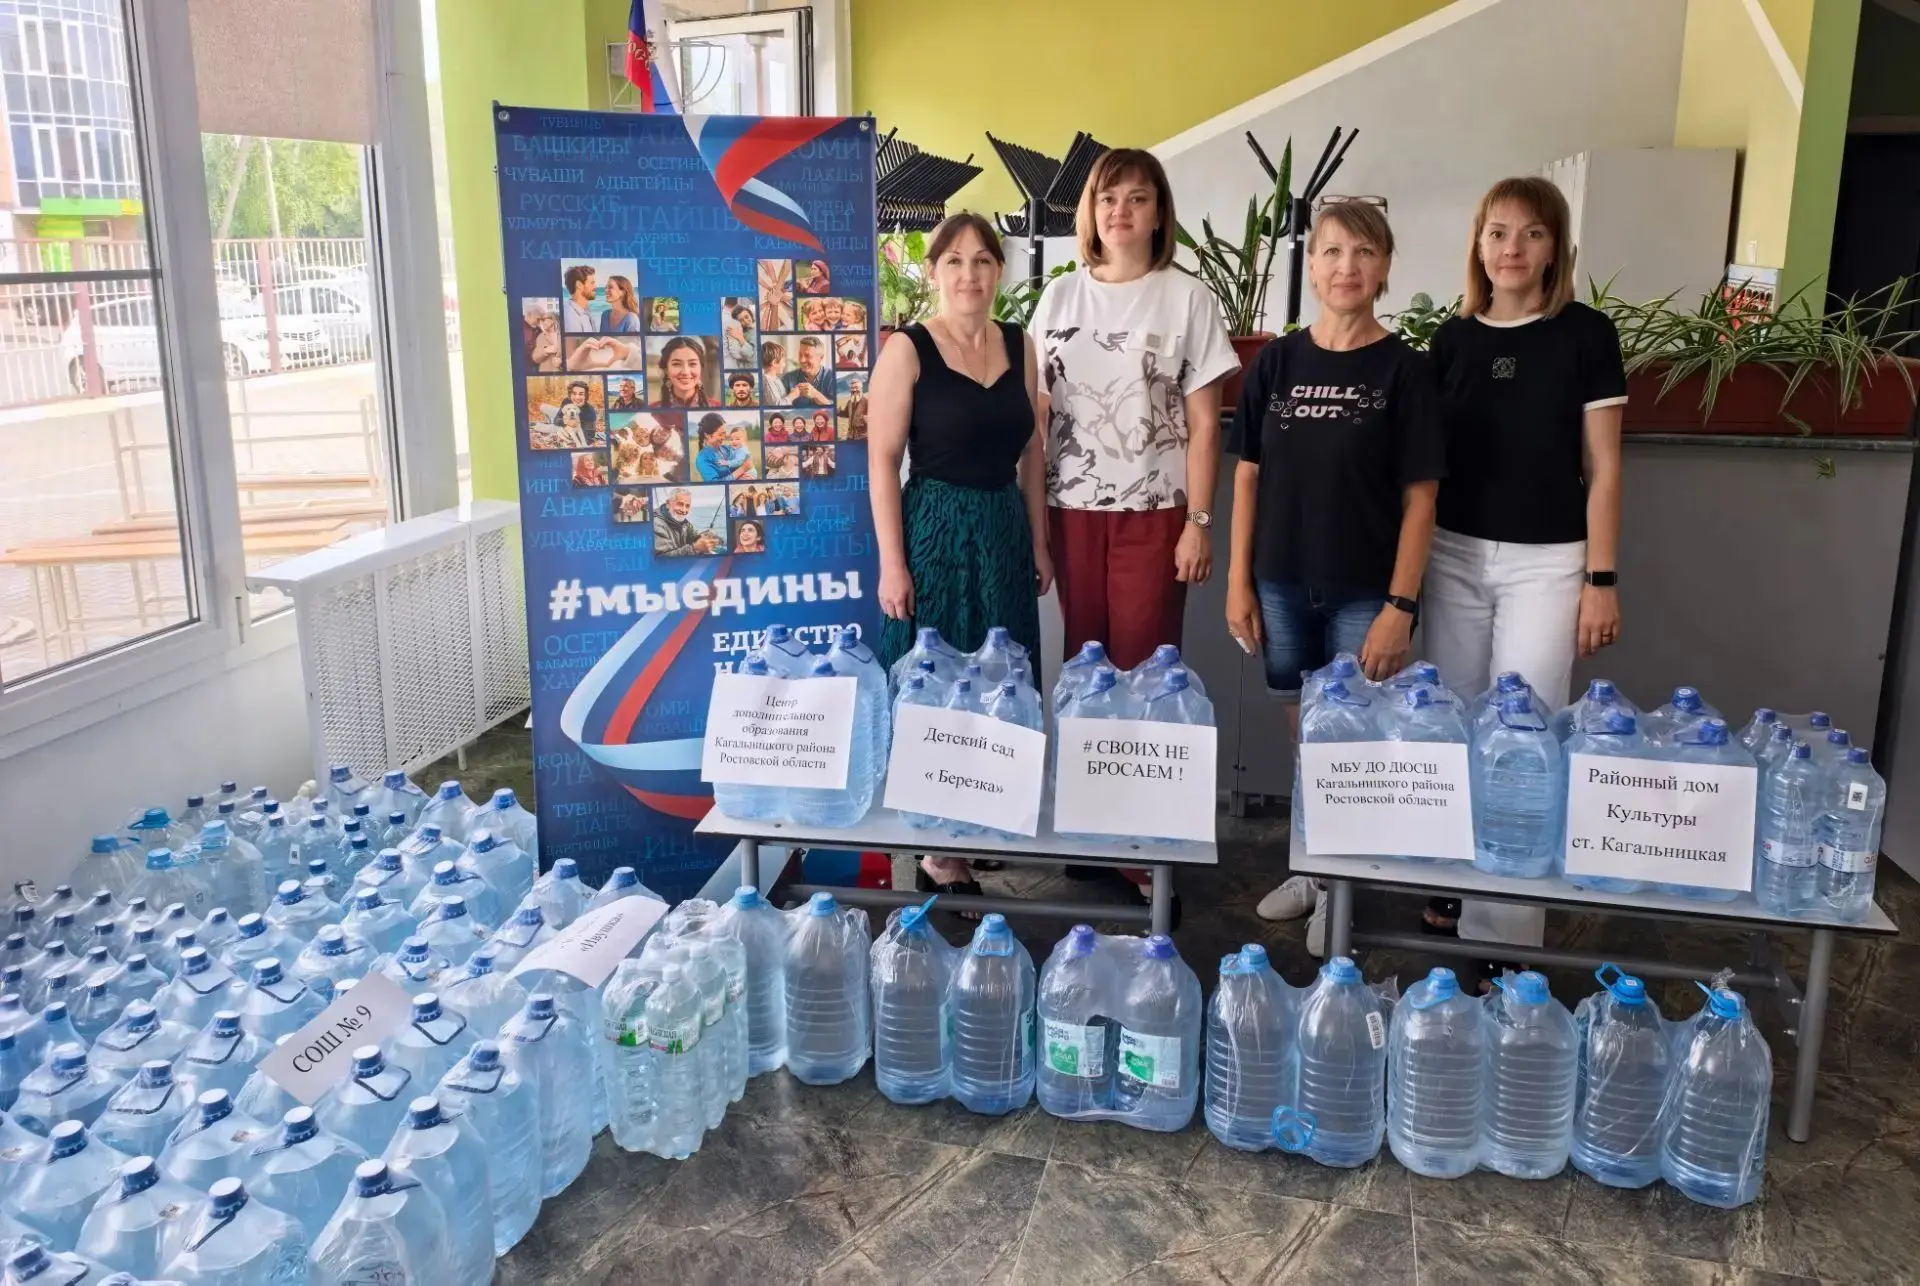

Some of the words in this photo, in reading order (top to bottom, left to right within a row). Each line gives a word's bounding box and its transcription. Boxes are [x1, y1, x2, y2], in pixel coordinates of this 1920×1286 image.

[513, 134, 631, 155] БАШКИРЫ
[790, 139, 862, 160] ОМИ
[504, 166, 585, 184] ЧУВАШИ
[1290, 385, 1360, 400] CHILL
[1294, 405, 1343, 418] OUT
[549, 570, 863, 621] #мыедины
[712, 622, 863, 656] ЕДИСТВО
[765, 696, 798, 708] Центр
[742, 724, 809, 737] образования
[715, 736, 794, 752] Кагальницкого
[796, 742, 836, 755] района
[923, 727, 988, 751] Детский
[991, 742, 1015, 759] сад
[1083, 741, 1092, 753] #
[1096, 740, 1160, 758] СВОИХ
[1165, 745, 1190, 760] НЕ
[720, 753, 780, 767] Ростовской
[782, 756, 826, 769] области
[1087, 761, 1173, 780] БРОСАЕМ
[1178, 767, 1184, 780] !
[1331, 762, 1361, 773] МБУ
[1365, 762, 1385, 774] ДО
[1389, 762, 1438, 775] ДЮСШ
[925, 771, 933, 780] «
[938, 769, 1004, 794] Березка»
[1316, 778, 1408, 790] Кагальницкого
[1412, 780, 1454, 792] района
[1588, 768, 1678, 791] Районный
[1684, 780, 1719, 794] дом
[1325, 793, 1395, 805] Ростовской
[1398, 794, 1447, 807] области
[1607, 803, 1697, 829] Культуры
[1572, 838, 1595, 851] ст.
[1601, 836, 1727, 863] Кагальницкая
[293, 1032, 342, 1074] СОШ
[333, 1016, 363, 1043] №
[357, 1005, 374, 1024] 9
